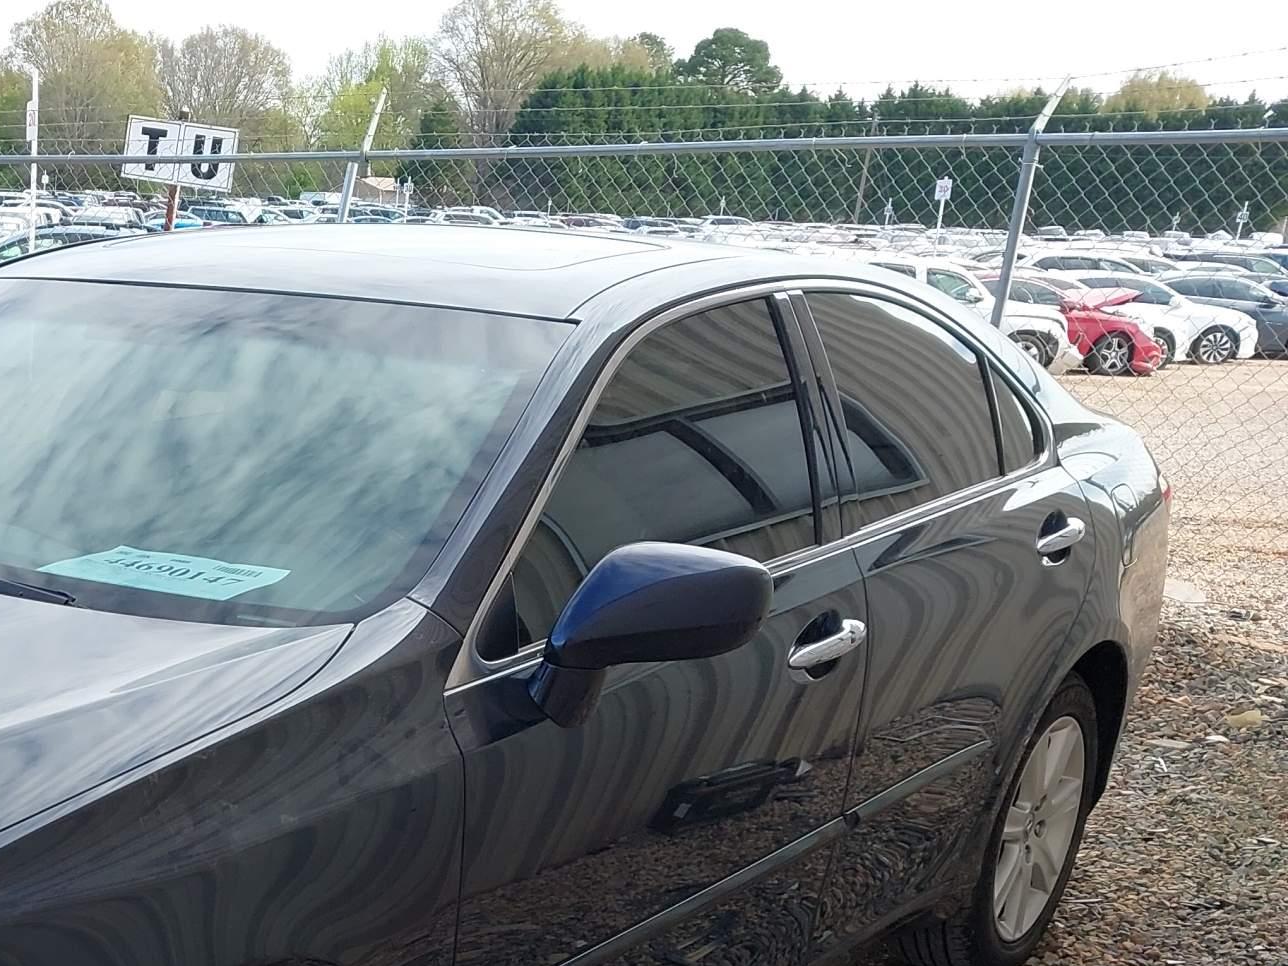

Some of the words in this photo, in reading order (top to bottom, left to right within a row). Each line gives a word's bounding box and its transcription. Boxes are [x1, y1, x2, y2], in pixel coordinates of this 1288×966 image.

[141, 126, 168, 172] T
[191, 134, 223, 180] U
[104, 558, 245, 586] 44690147
